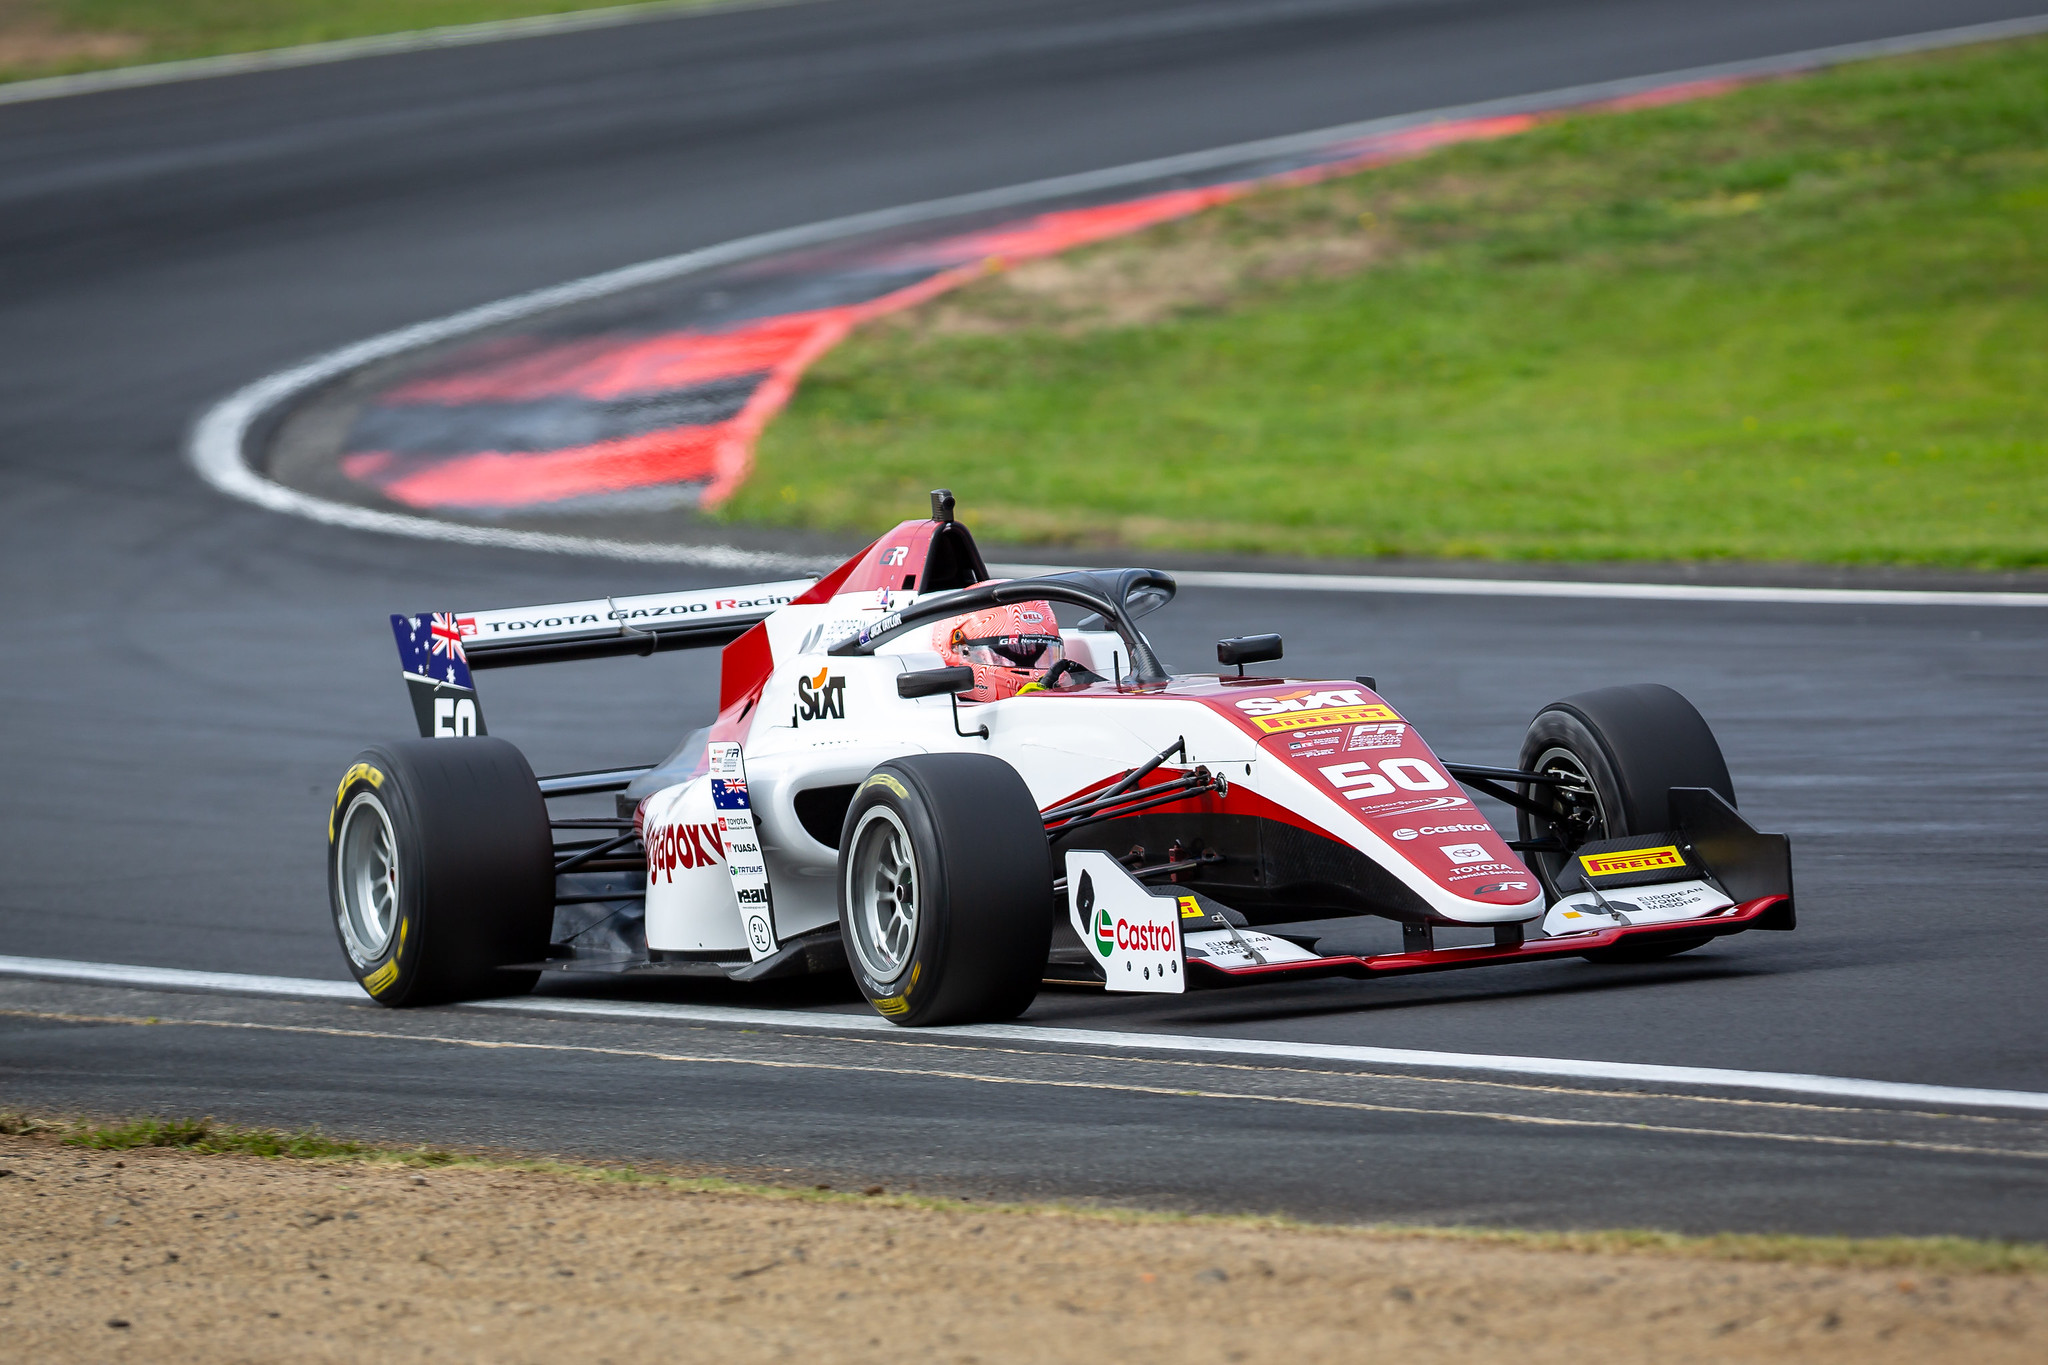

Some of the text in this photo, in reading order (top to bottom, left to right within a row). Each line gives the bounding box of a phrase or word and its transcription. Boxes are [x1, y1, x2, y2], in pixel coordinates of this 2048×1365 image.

[879, 546, 909, 566] GR
[486, 594, 799, 632] TOYOTA GAZOO Racin
[869, 620, 884, 638] JACK
[881, 613, 903, 631] TAYLOR
[434, 698, 477, 739] 50
[1263, 708, 1387, 728] PIRELLI
[1306, 728, 1342, 737] Castrol
[1317, 757, 1450, 800] 50
[1419, 823, 1492, 835] Castrol
[732, 843, 758, 852] YUASA
[1450, 863, 1512, 874] TOYOTA
[1588, 852, 1677, 872] PIRELLI
[1448, 871, 1488, 882] Financial
[1473, 881, 1528, 895] GR
[1637, 887, 1704, 901] EUROPEAN
[1641, 896, 1684, 906] STONE
[1647, 896, 1702, 910] MASONS
[1117, 918, 1176, 952] Castrol
[1205, 936, 1272, 948] EUREAN
